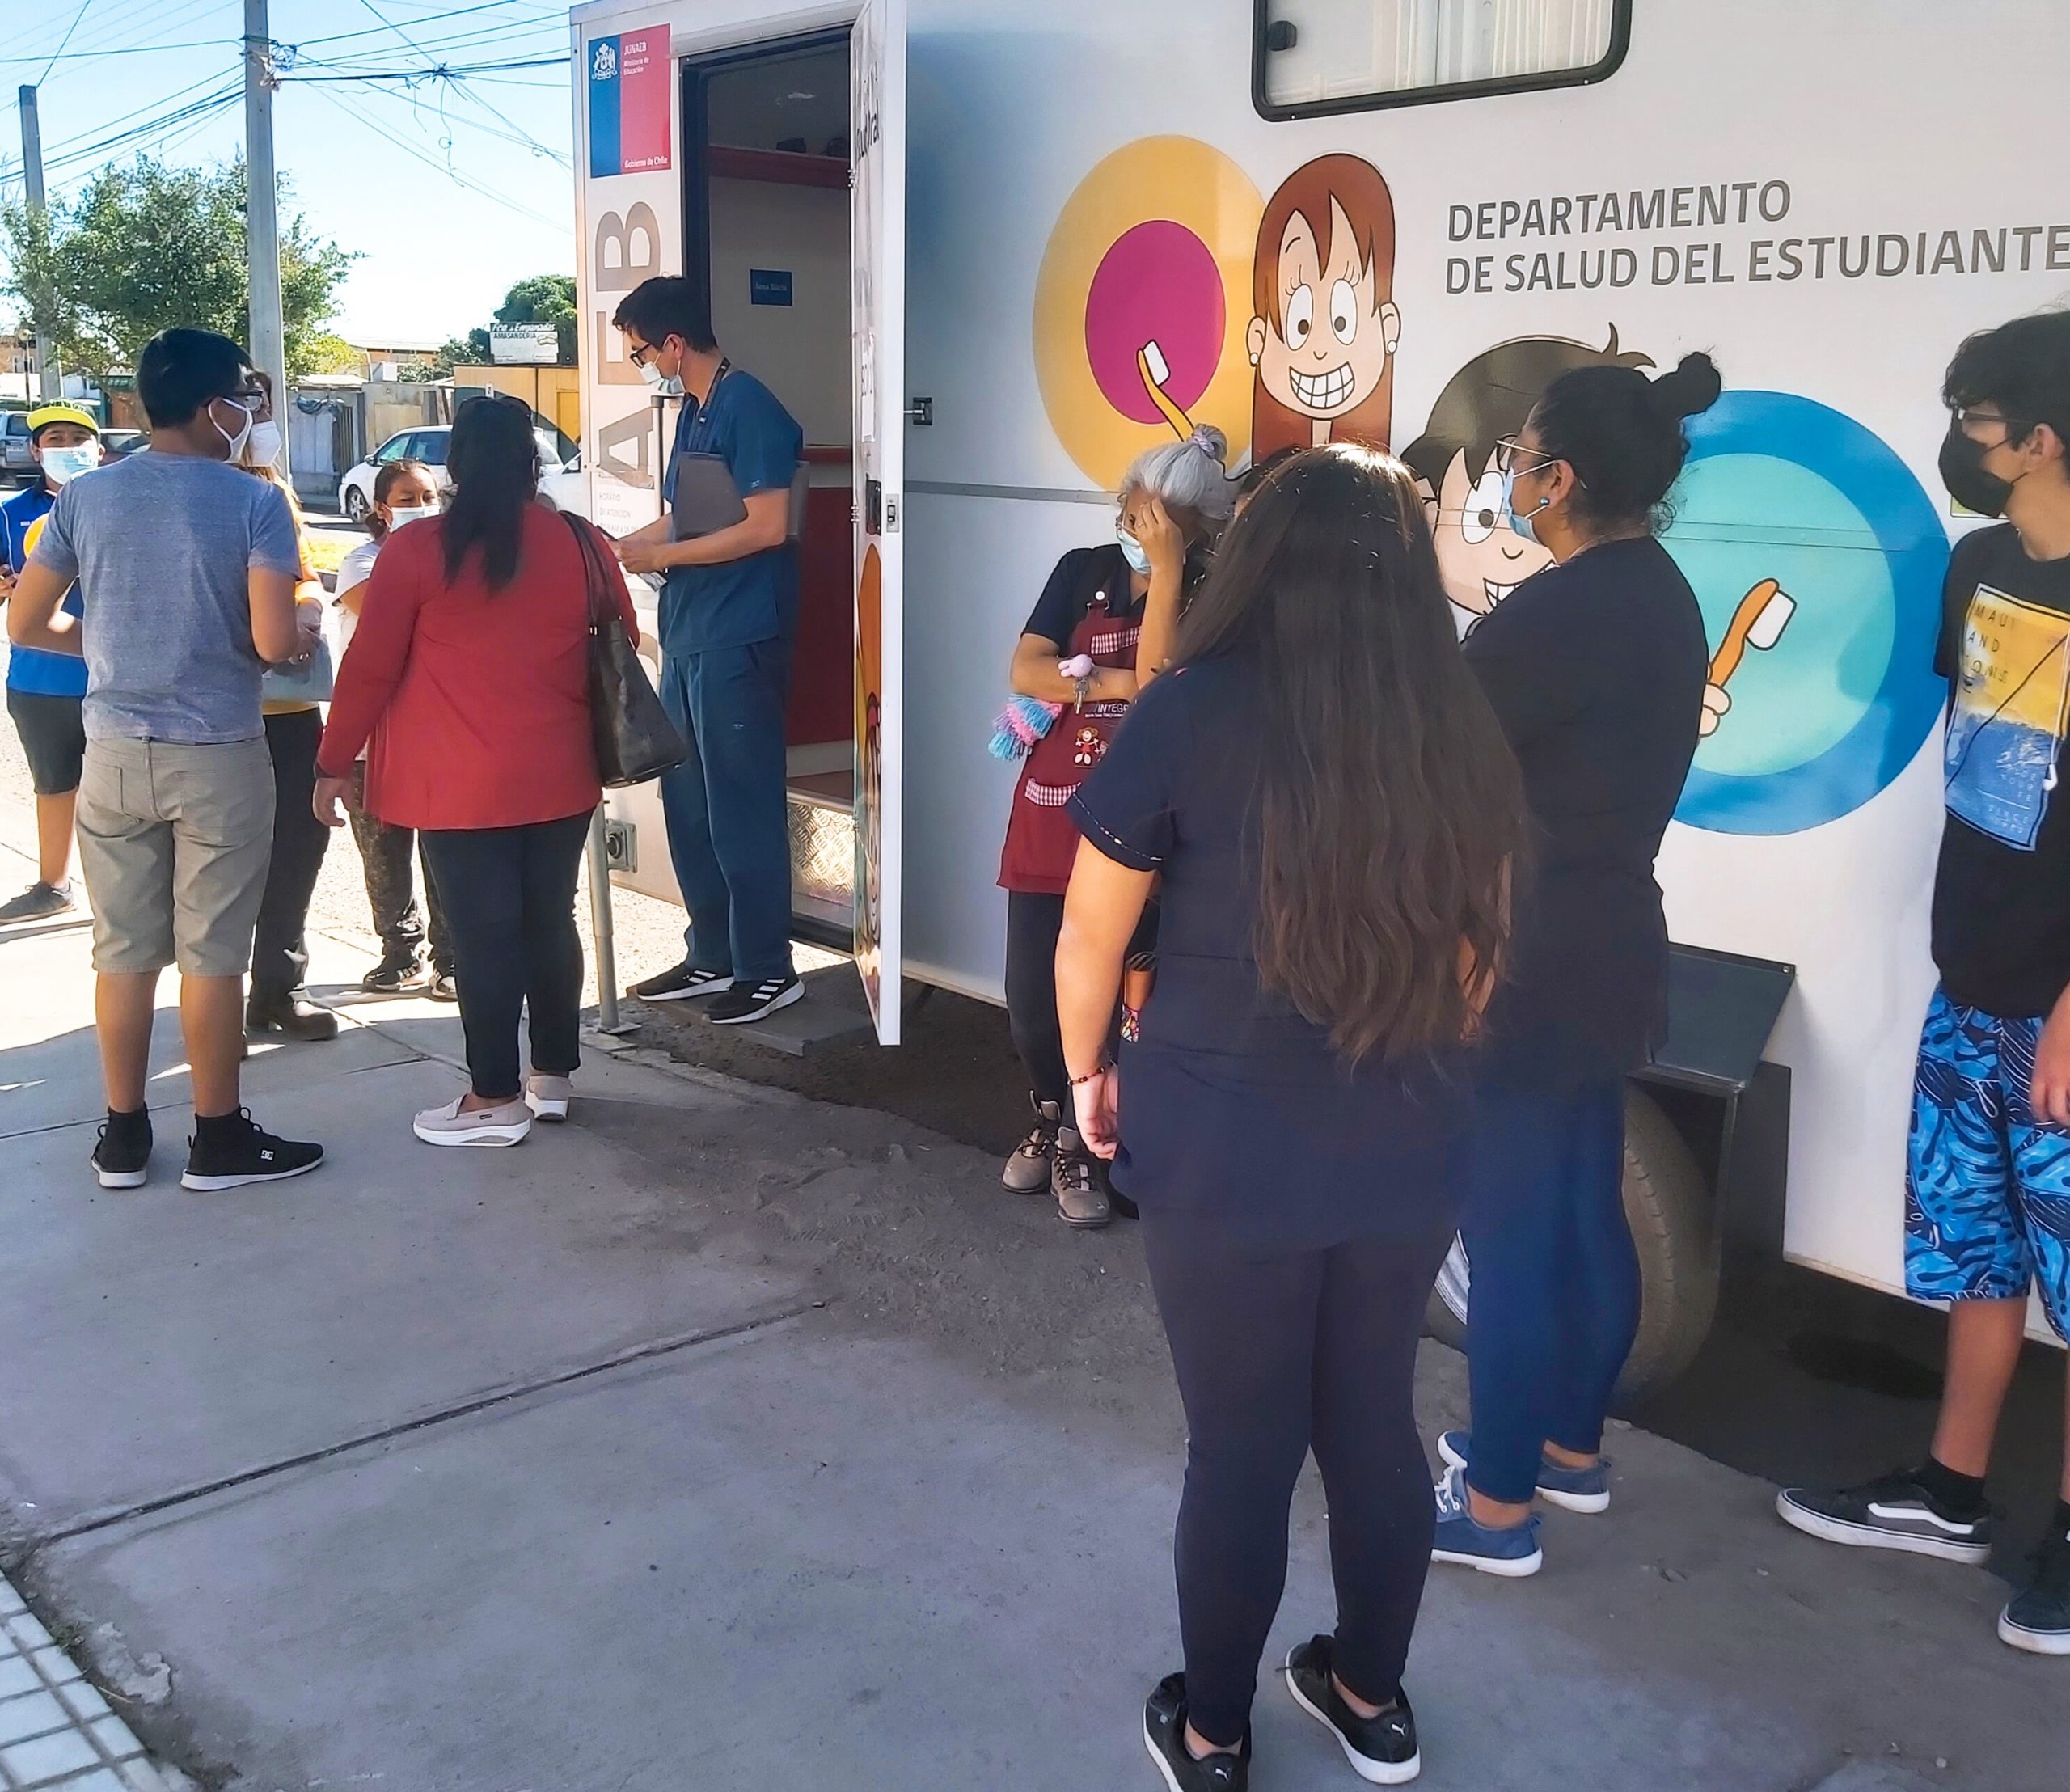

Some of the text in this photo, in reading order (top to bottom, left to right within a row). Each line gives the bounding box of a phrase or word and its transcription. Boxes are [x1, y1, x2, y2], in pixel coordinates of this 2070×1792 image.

[623, 41, 647, 56] JUNAEB
[624, 159, 647, 169] Gobierno
[654, 155, 668, 165] Chile
[1448, 180, 1791, 242] DEPARTAMENTO
[1446, 225, 2070, 294] DE SALUD DEL ESTUDIANTE
[1967, 631, 2000, 653] AND
